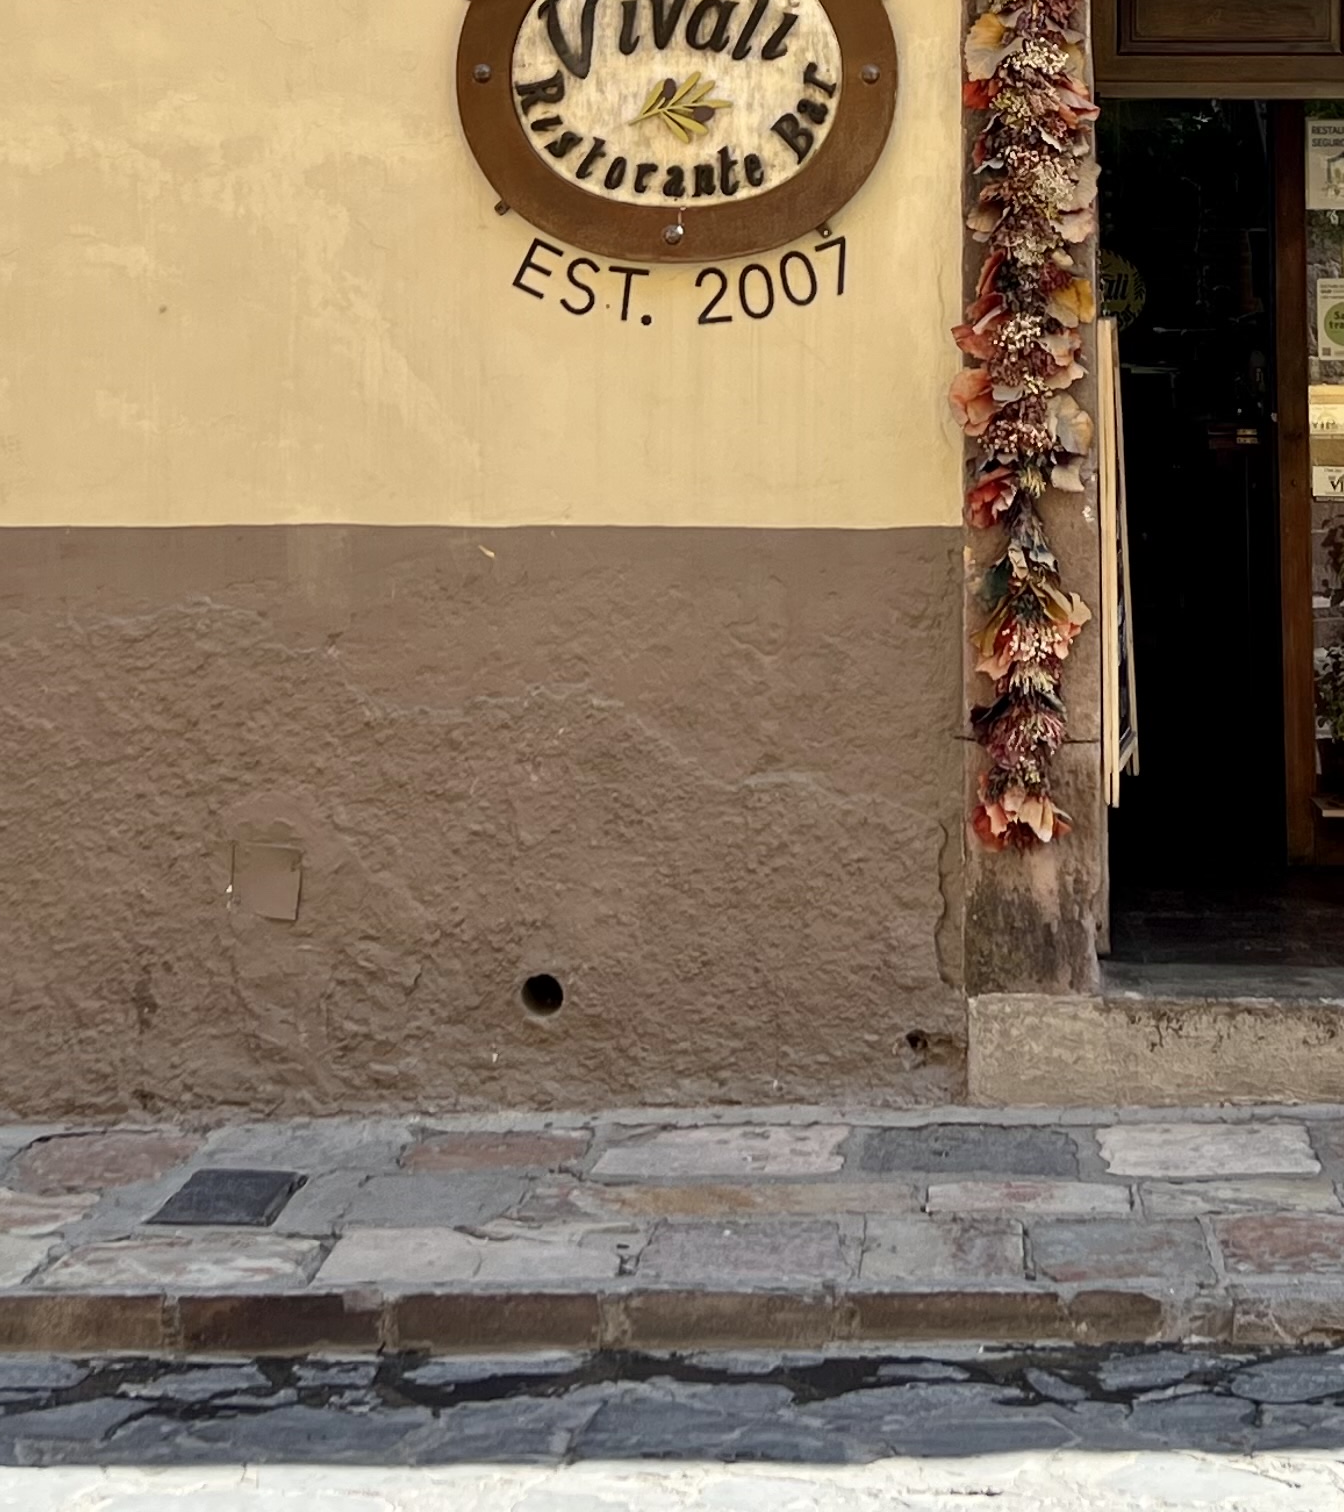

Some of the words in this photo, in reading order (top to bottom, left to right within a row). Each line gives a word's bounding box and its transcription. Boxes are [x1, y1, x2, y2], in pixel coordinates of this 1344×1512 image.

[515, 70, 766, 198] Ristorante
[771, 62, 837, 164] Bar
[512, 237, 652, 326] EST.
[694, 236, 848, 325] 2007
